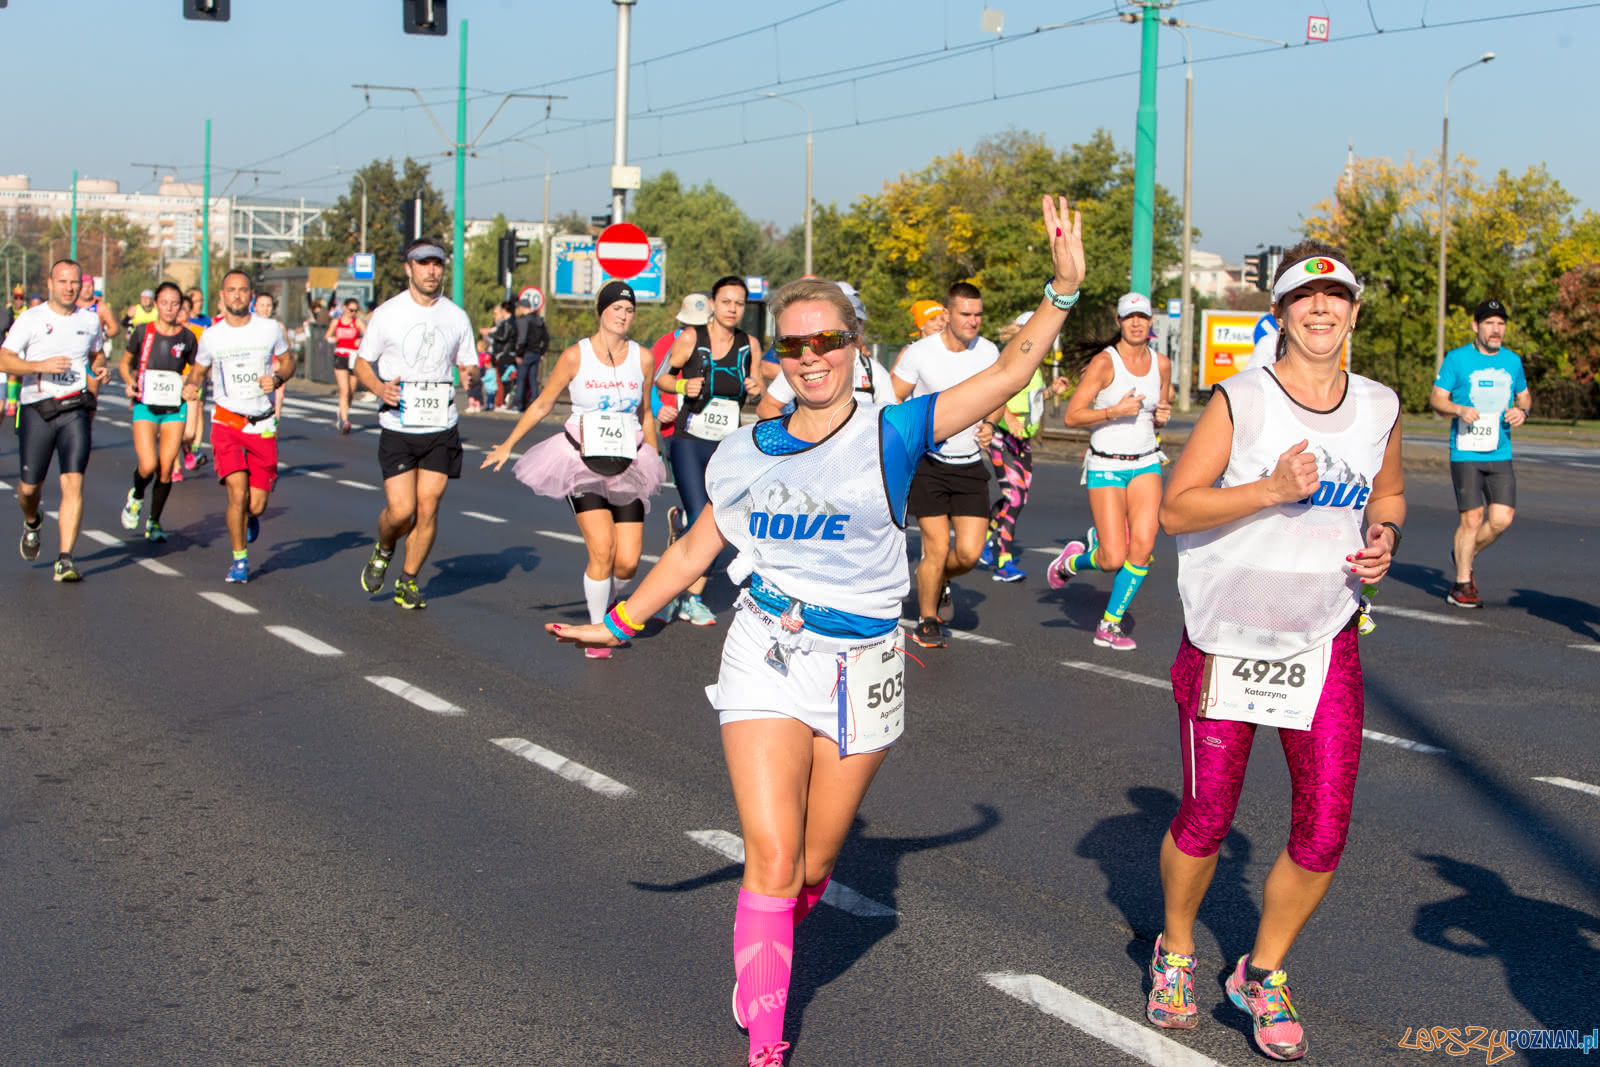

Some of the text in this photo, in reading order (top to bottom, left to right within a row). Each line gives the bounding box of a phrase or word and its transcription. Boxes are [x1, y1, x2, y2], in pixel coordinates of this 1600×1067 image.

[1312, 22, 1326, 34] 60
[231, 372, 258, 384] 1500
[152, 382, 175, 392] 2561
[414, 398, 440, 409] 2193
[704, 413, 729, 426] 1823
[598, 427, 623, 439] 746
[1299, 480, 1371, 510] OVE
[1232, 658, 1307, 689] 4928
[867, 671, 905, 709] 503
[1245, 688, 1288, 700] Katarzyna
